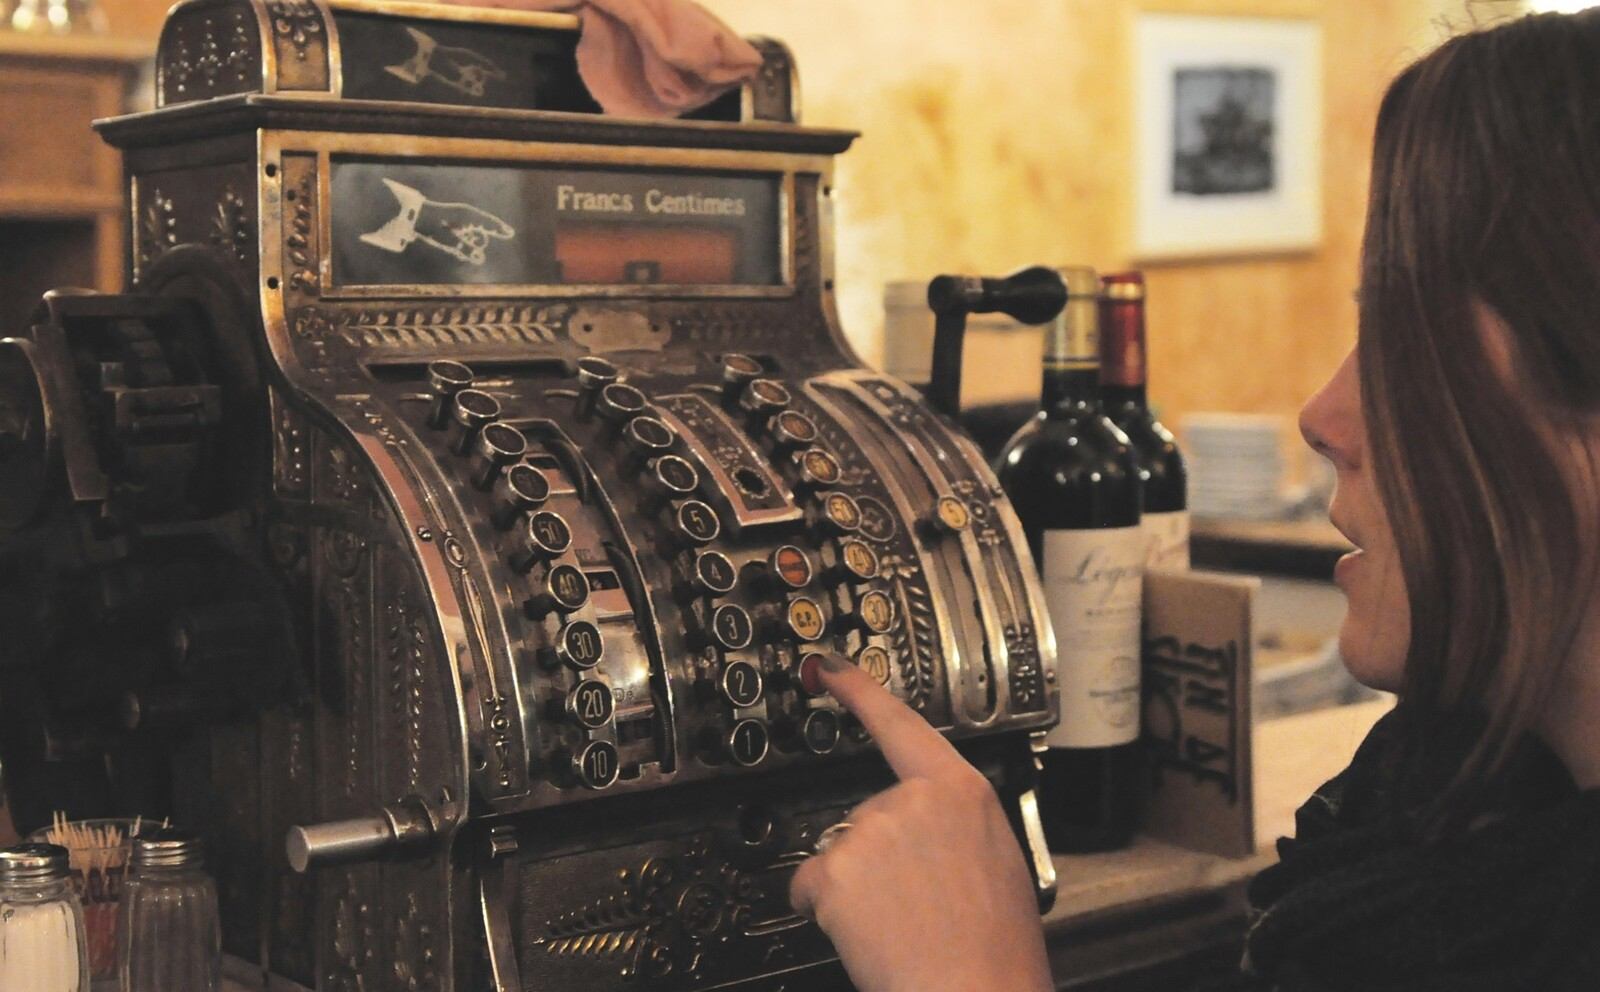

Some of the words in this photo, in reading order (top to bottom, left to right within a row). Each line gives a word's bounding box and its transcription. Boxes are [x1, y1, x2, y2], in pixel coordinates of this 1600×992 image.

[556, 185, 633, 212] Francs
[645, 189, 746, 215] Centimes
[689, 509, 707, 534] 5
[710, 563, 722, 581] 4
[558, 575, 577, 599] 40
[870, 599, 886, 625] 30
[725, 613, 738, 641] 3
[571, 630, 593, 654] 30
[863, 653, 883, 681] 20
[734, 669, 748, 697] 2
[582, 688, 605, 718] 20
[590, 749, 608, 780] 10
